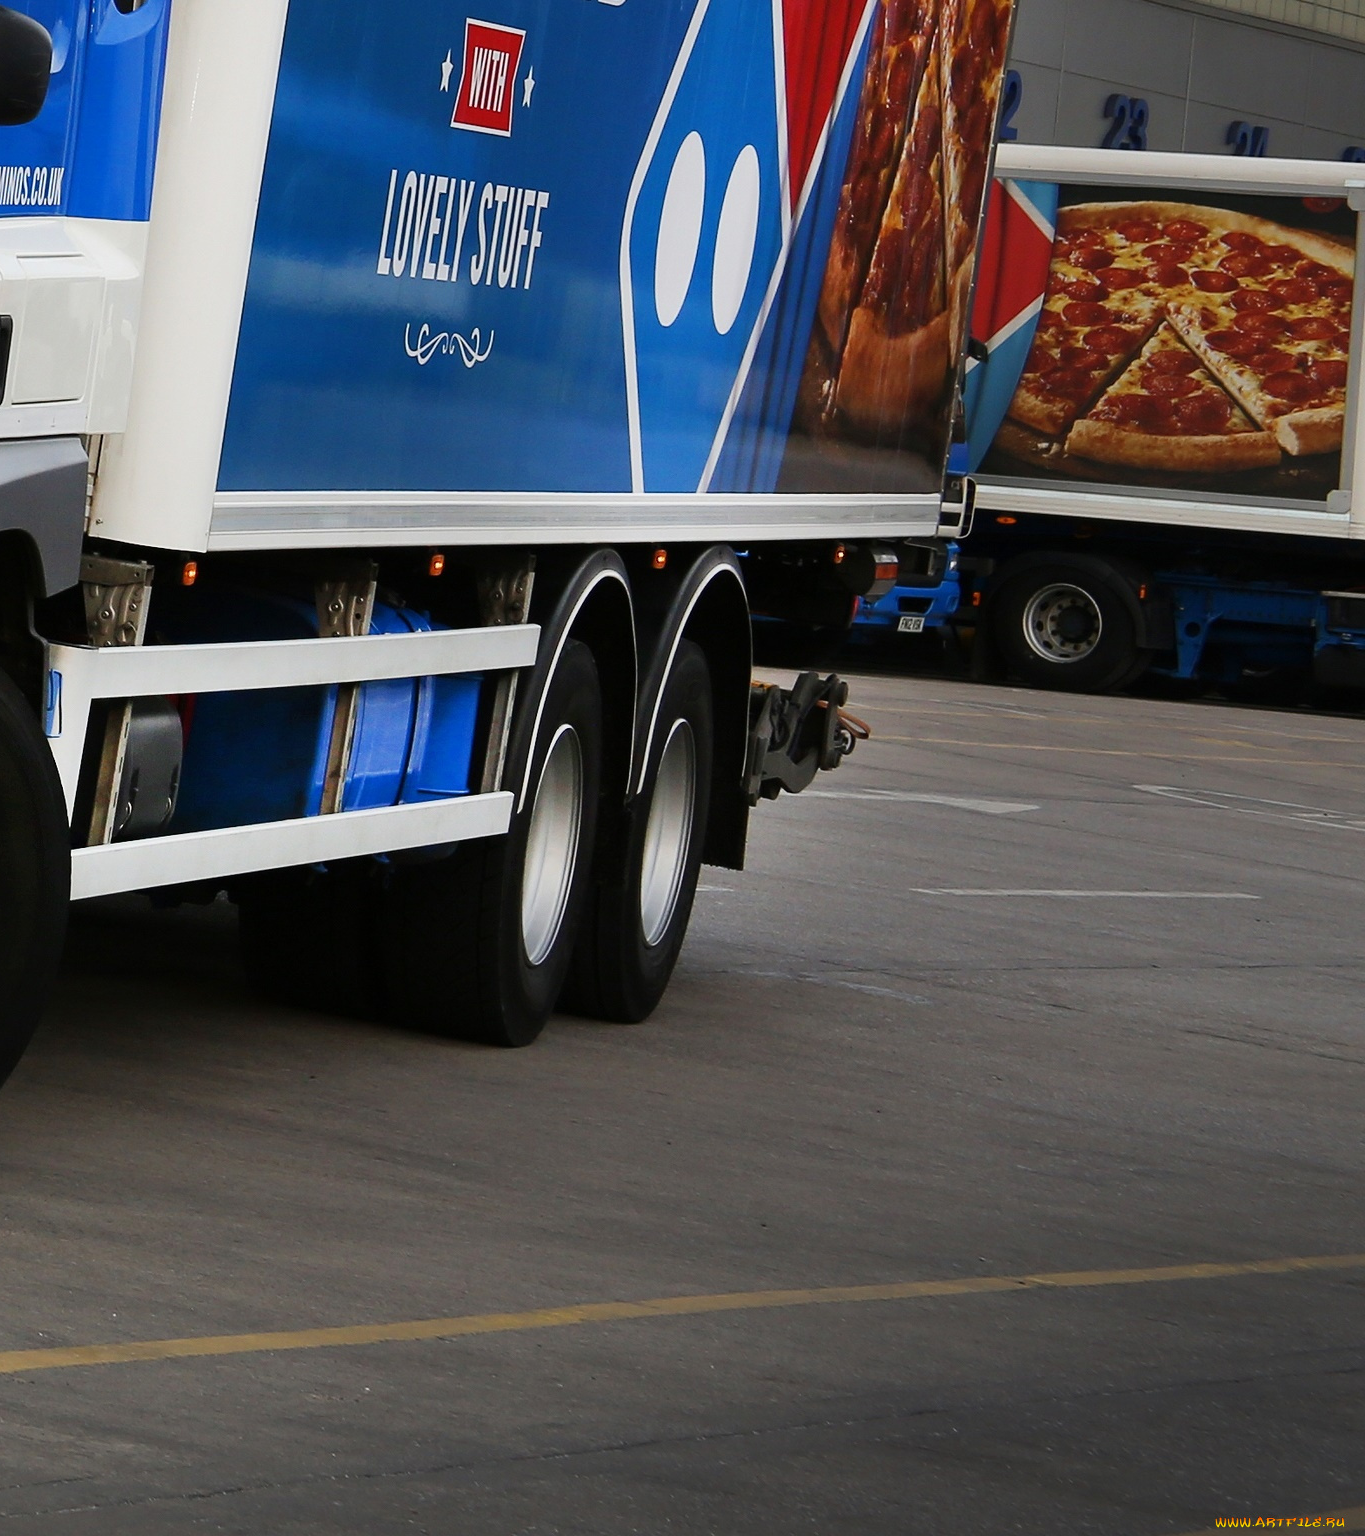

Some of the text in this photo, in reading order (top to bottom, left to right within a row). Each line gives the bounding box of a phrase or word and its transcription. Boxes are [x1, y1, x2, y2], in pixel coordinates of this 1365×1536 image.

[469, 46, 509, 113] WITH
[1100, 93, 1150, 151] 23
[377, 169, 549, 290] LOVELY STUFF
